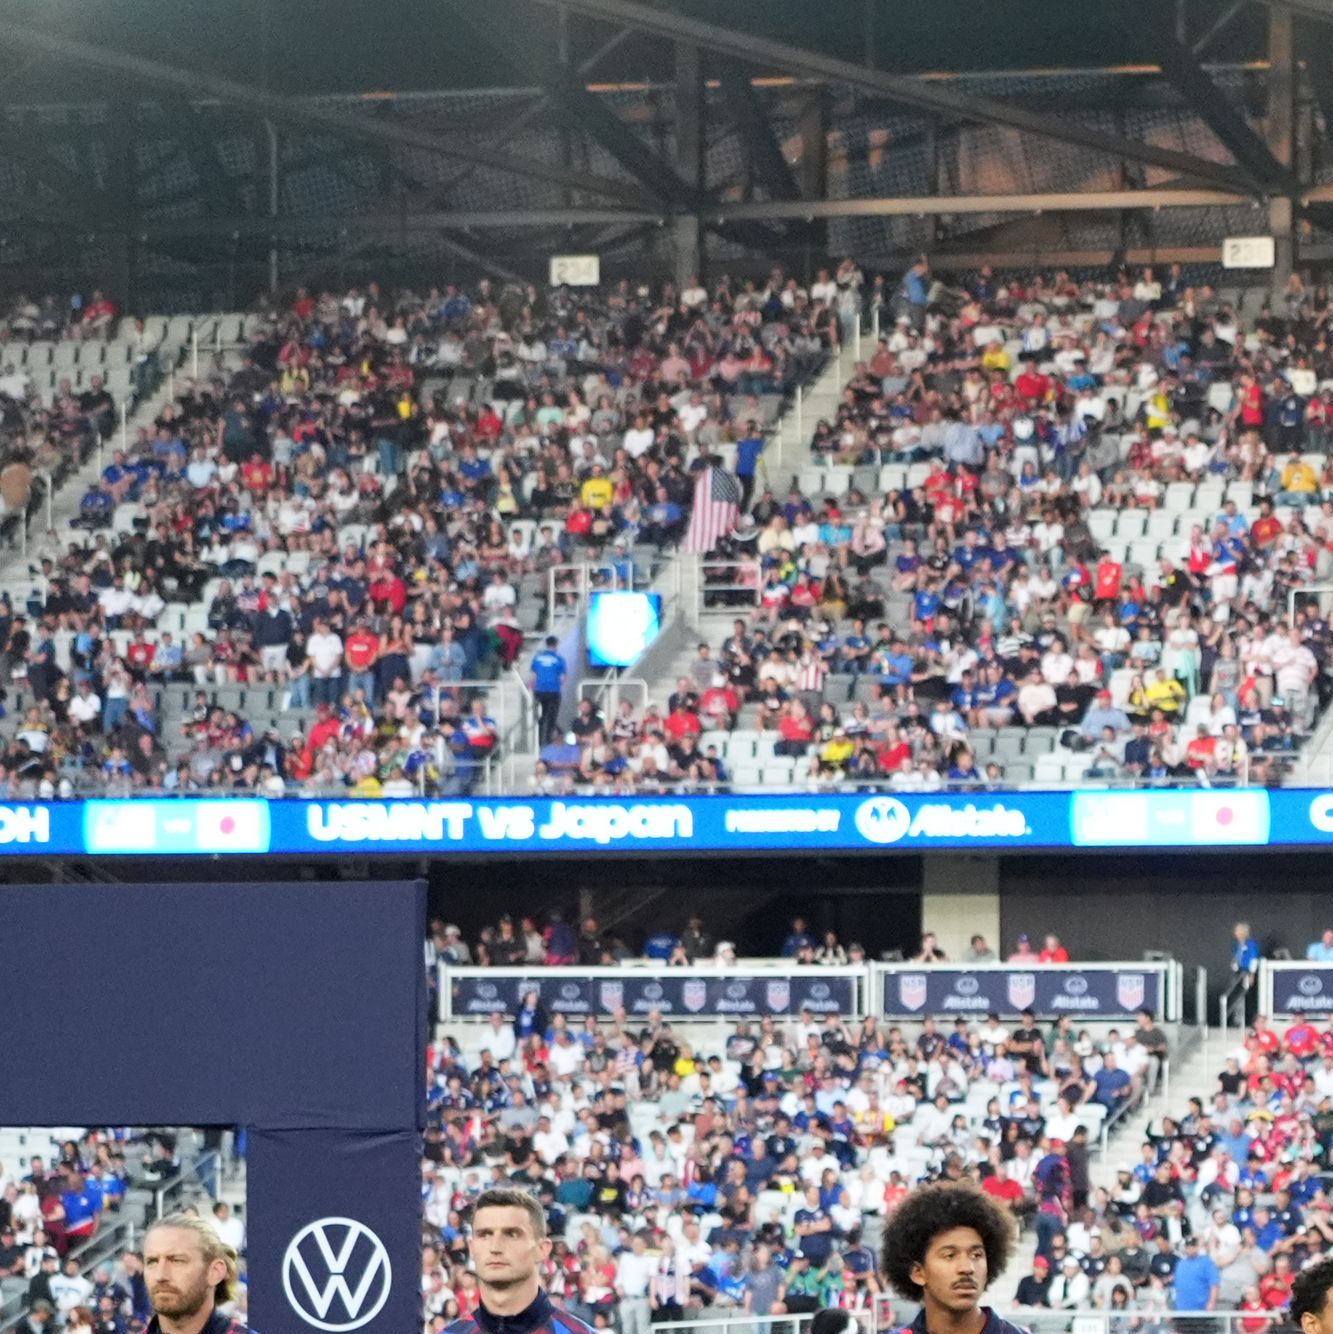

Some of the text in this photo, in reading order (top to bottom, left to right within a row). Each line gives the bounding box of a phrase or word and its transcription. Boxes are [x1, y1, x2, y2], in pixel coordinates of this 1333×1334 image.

[308, 804, 472, 842] USMNT
[478, 809, 535, 840] vs
[540, 801, 693, 843] Japan
